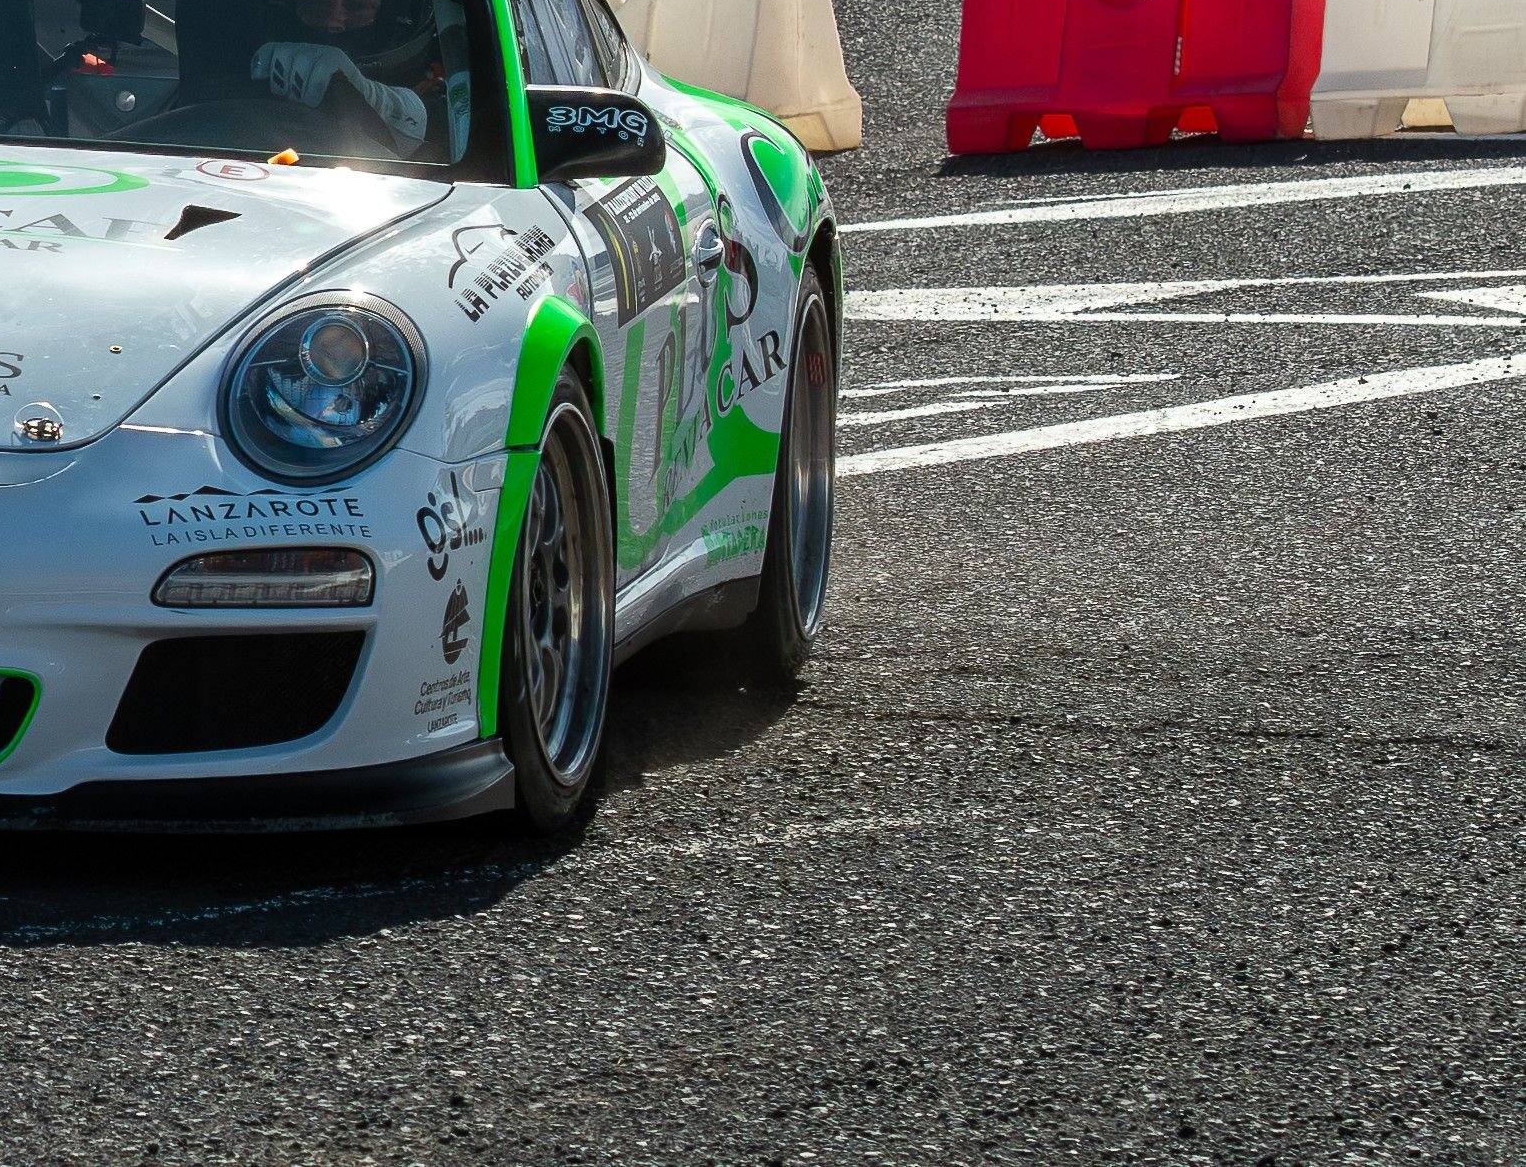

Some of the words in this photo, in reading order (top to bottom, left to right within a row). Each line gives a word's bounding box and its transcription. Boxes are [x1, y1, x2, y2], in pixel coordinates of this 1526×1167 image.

[546, 106, 648, 137] 3MG
[717, 330, 787, 417] CAR
[139, 498, 365, 526] LANZAROTE
[151, 531, 180, 547] LA
[184, 525, 239, 544] ISLA
[244, 522, 373, 539] DIFERENTE
